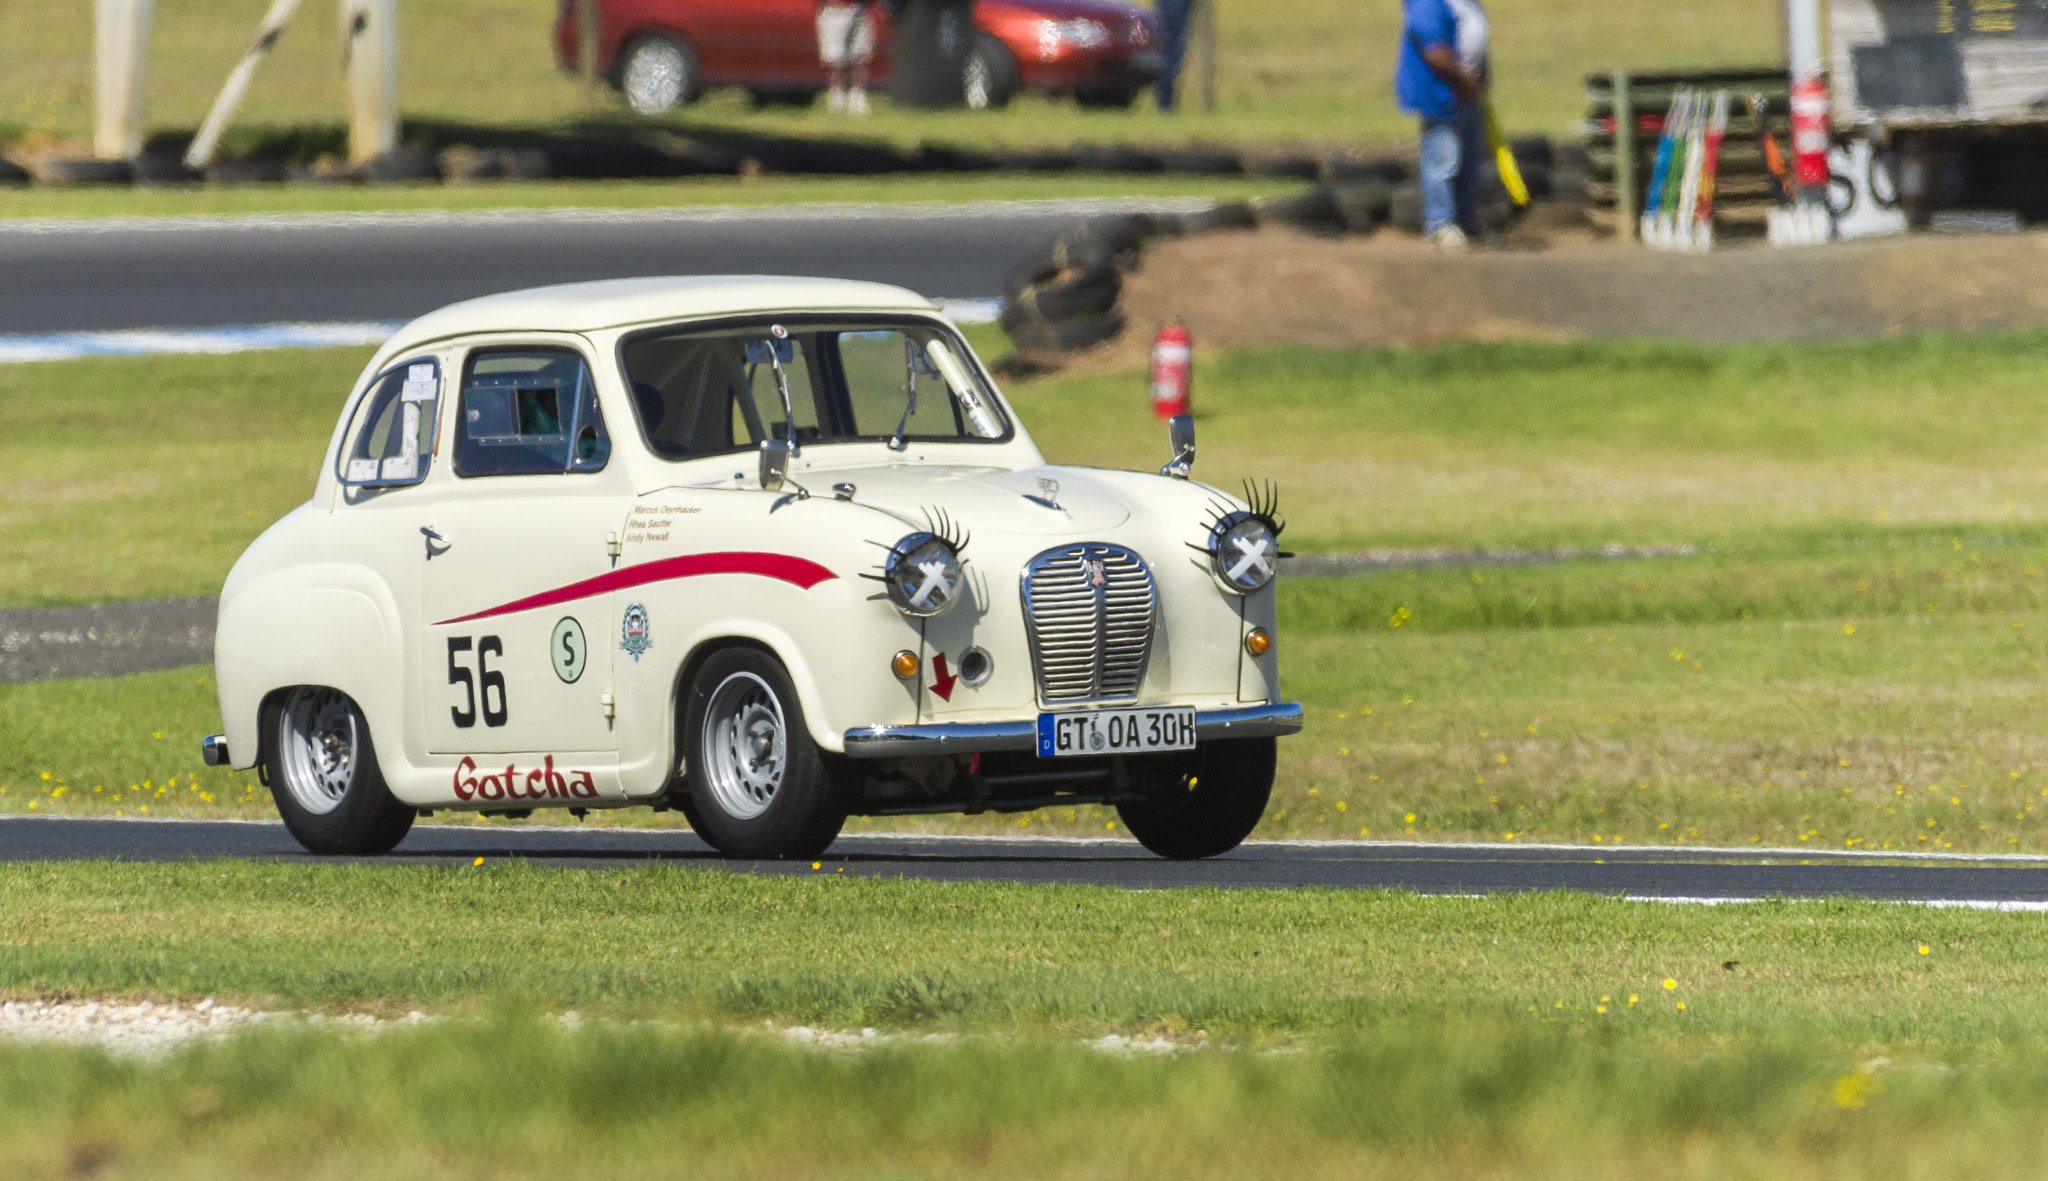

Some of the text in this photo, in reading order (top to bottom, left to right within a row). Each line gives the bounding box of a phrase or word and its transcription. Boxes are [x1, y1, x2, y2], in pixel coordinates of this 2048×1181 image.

[634, 505, 659, 514] Marcus
[626, 533, 644, 543] Andy
[562, 631, 576, 667] S
[447, 635, 508, 728] 56
[1056, 717, 1088, 750] GT
[453, 754, 600, 801] Gotcha
